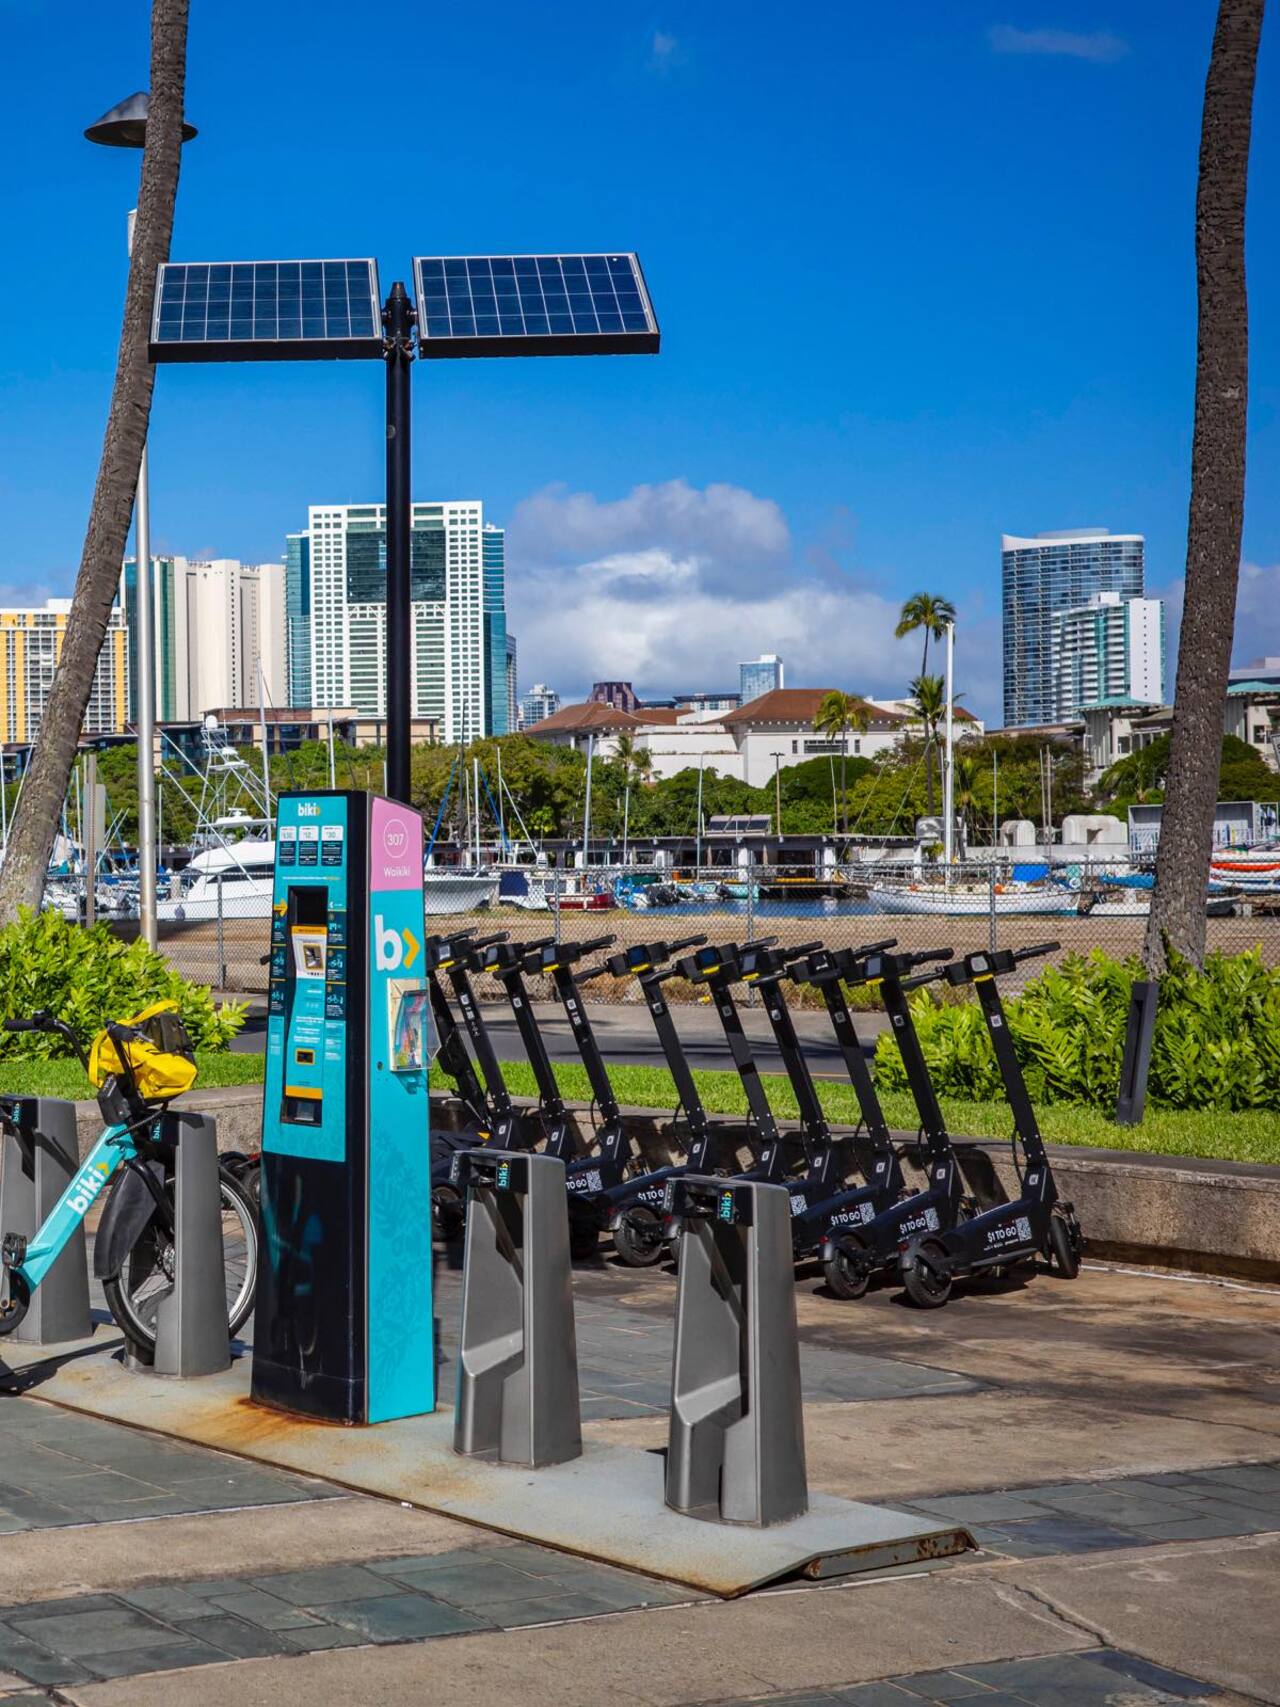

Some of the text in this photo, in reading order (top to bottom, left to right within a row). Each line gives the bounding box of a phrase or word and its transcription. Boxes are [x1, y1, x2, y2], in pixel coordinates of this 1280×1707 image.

[298, 802, 317, 817] biki
[387, 833, 405, 846] 307
[383, 865, 411, 878] Waikiki
[375, 914, 403, 971] b
[498, 1167, 508, 1187] biki
[576, 1179, 588, 1188] GO
[66, 1166, 106, 1215] biki
[646, 1191, 658, 1200] TO
[657, 1189, 665, 1198] G
[720, 1197, 731, 1218] biki
[831, 1215, 839, 1226] $1
[838, 1213, 849, 1224] TO
[849, 1211, 861, 1221] GO
[899, 1217, 926, 1234] $1 TO GO
[987, 1226, 1017, 1243] $1 TO GO
